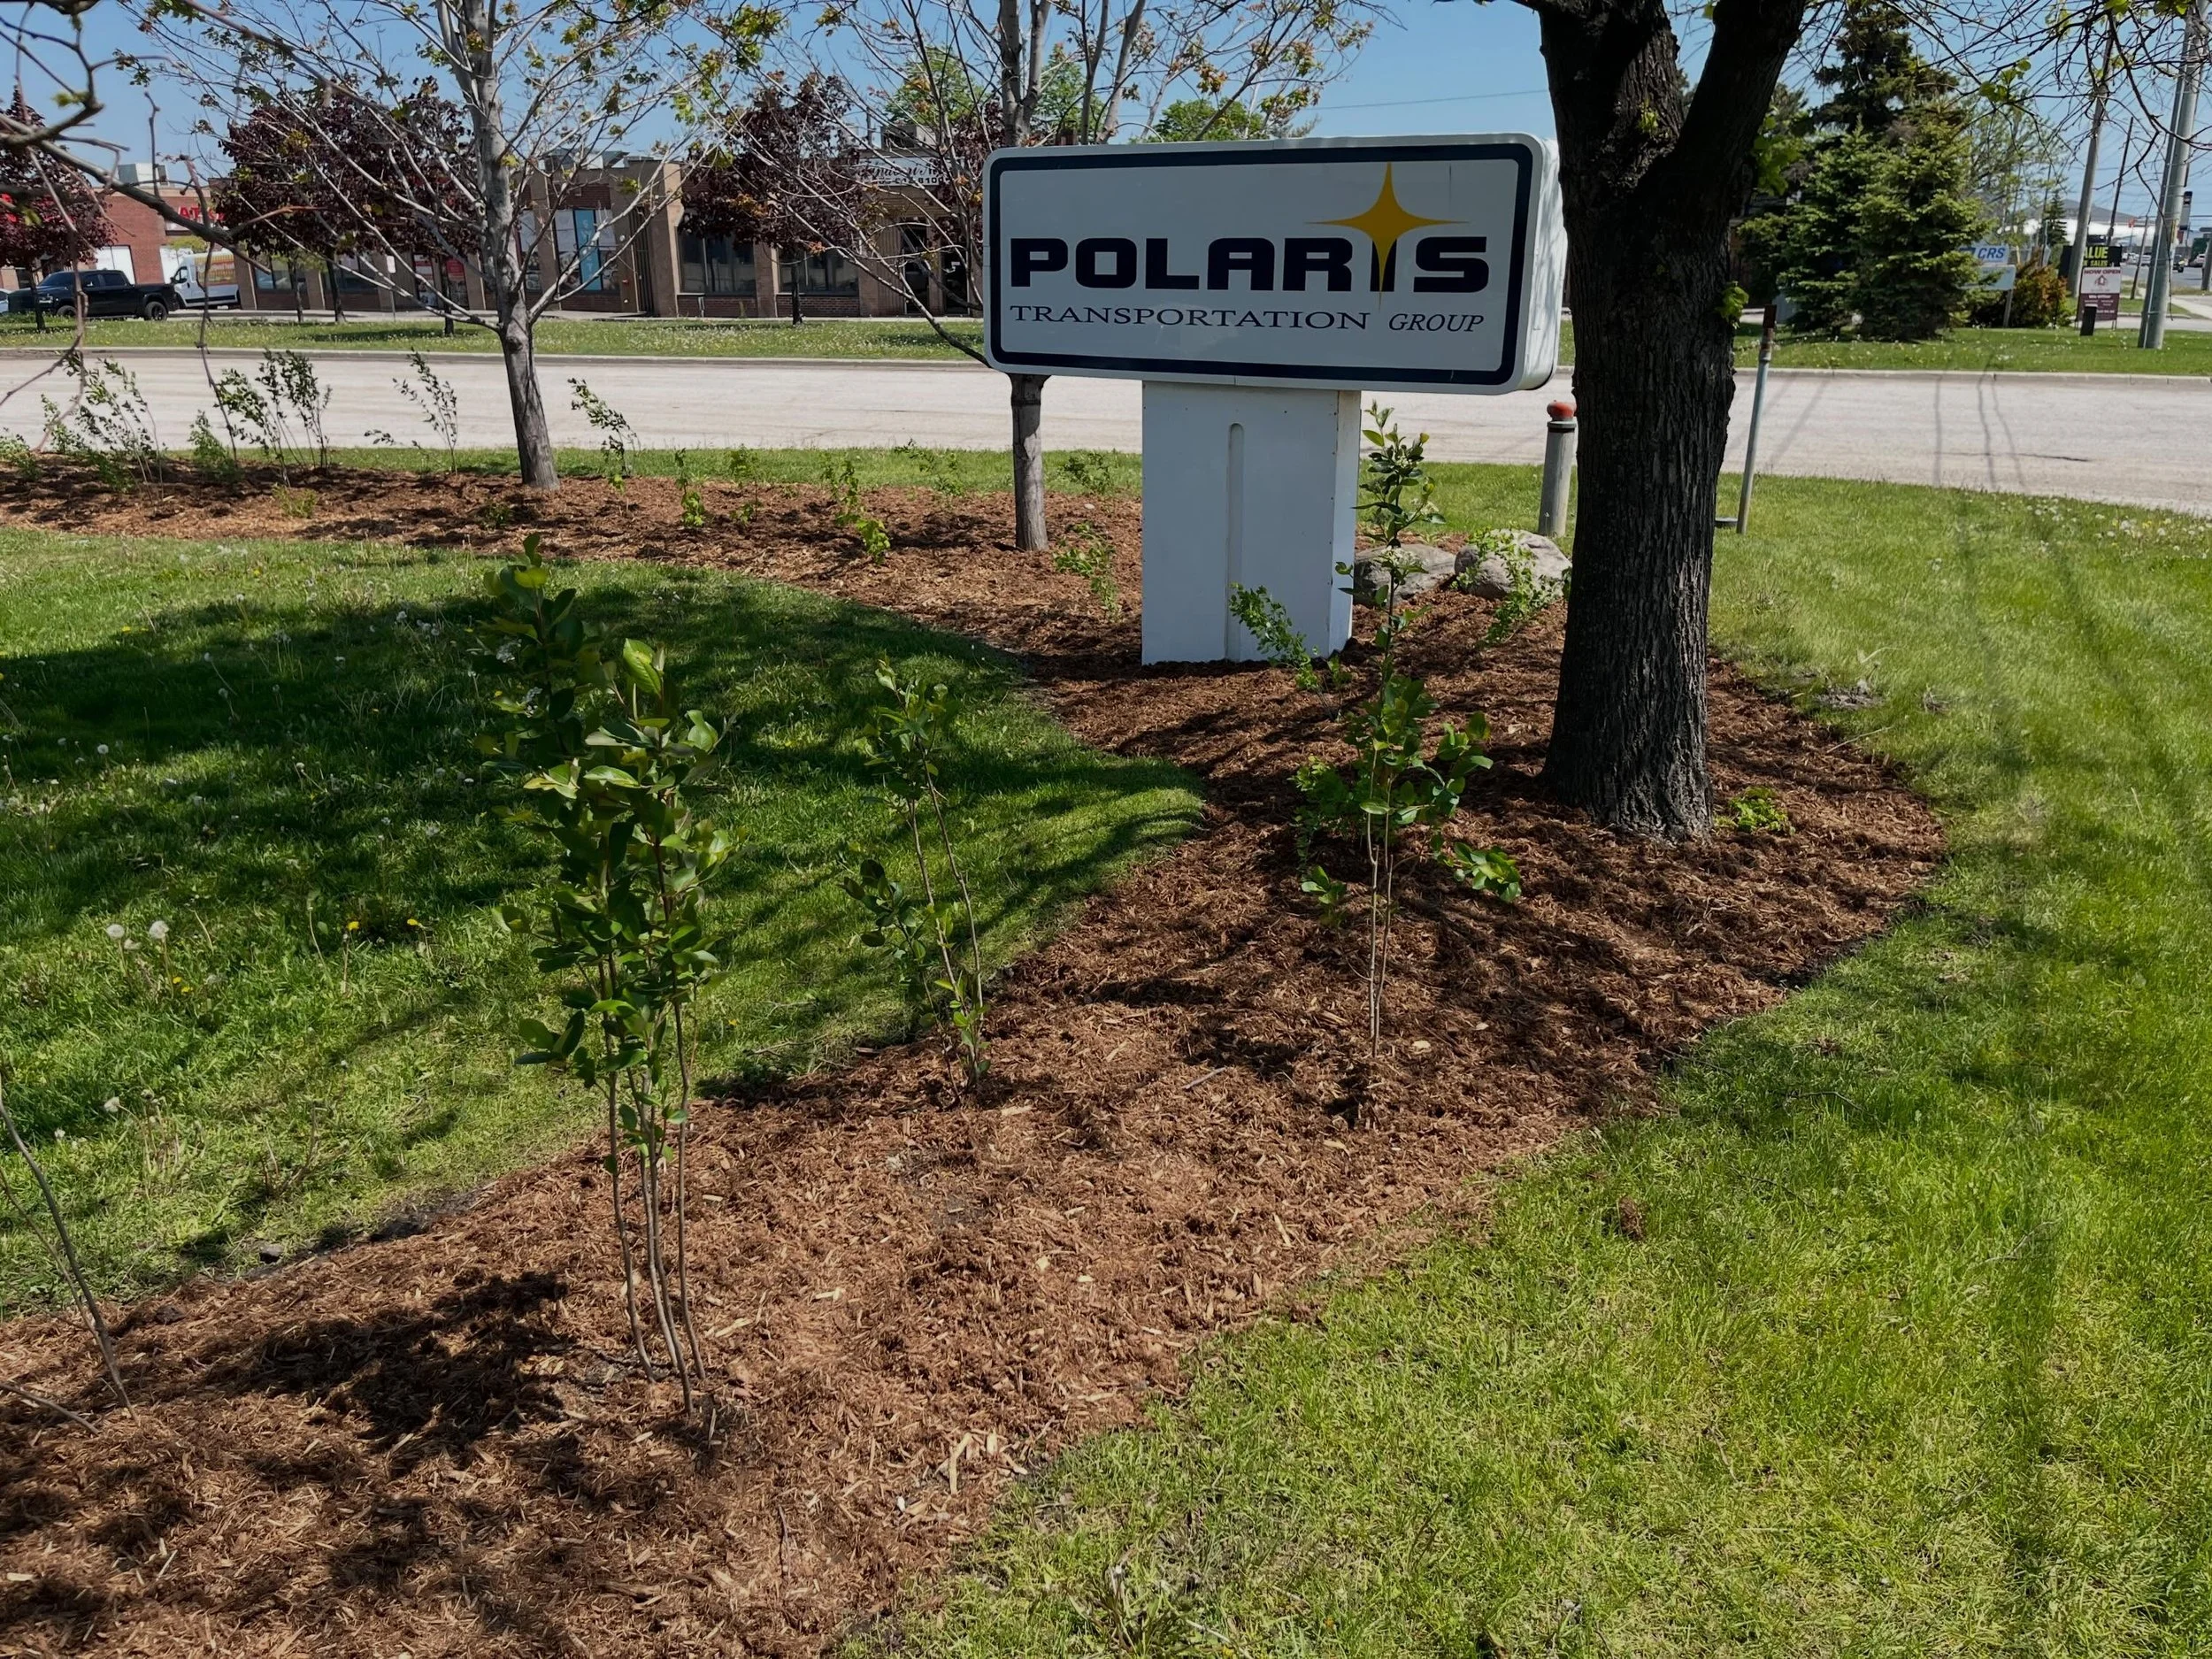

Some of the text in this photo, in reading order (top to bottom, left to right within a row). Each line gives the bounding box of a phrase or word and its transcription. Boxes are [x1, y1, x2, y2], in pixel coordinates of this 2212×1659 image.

[1978, 247, 2006, 259] CRS
[2084, 246, 2108, 259] ALUE
[1010, 236, 1489, 293] POLARIS
[1010, 305, 1485, 332] TRANSPORTATION GROUP
